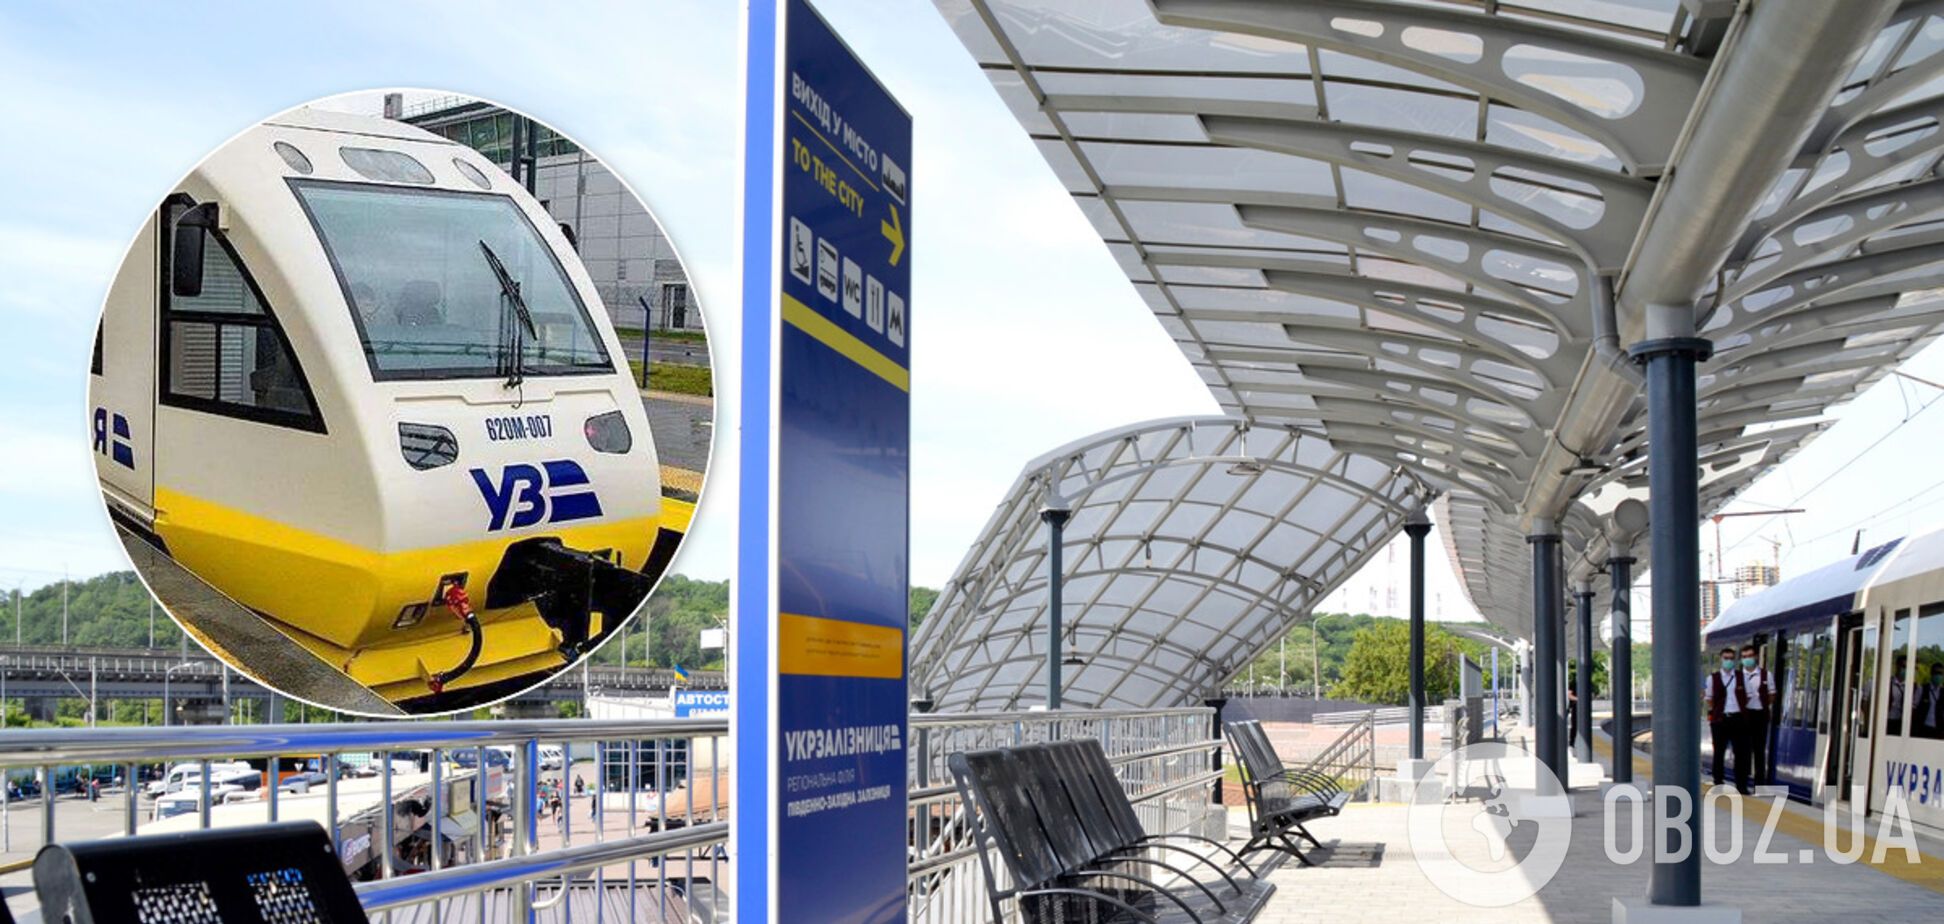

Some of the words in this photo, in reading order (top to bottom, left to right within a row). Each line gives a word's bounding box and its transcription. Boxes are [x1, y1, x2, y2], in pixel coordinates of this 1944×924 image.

[792, 71, 831, 133] ВИХІД
[833, 111, 842, 136] У
[843, 122, 878, 172] МІСТО
[792, 137, 811, 172] TO
[812, 155, 837, 196] THE
[838, 180, 864, 218] CITY
[844, 274, 860, 304] WC
[785, 724, 892, 762] УКРЗАЛІЗНИЦЯ
